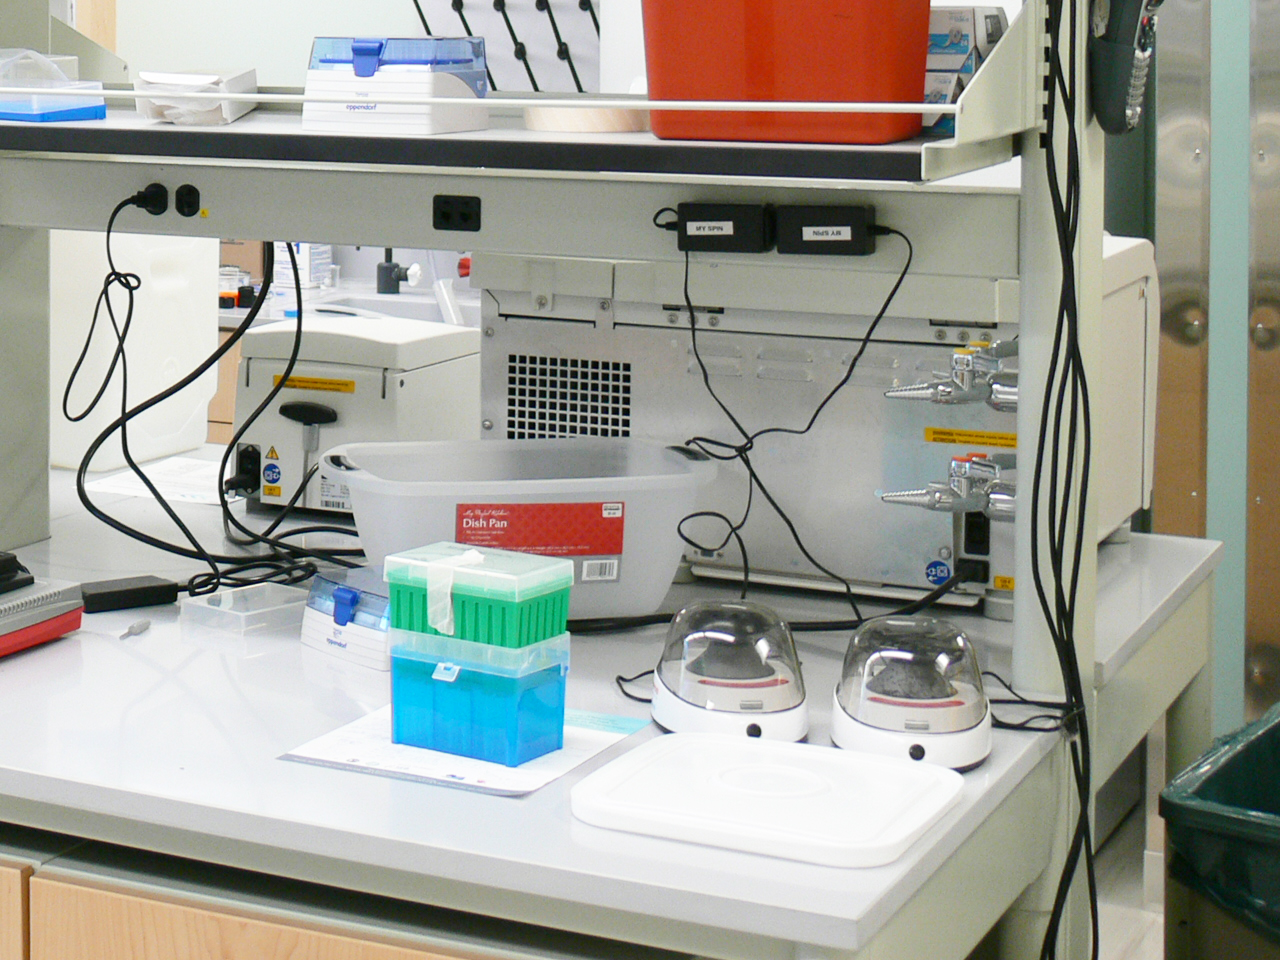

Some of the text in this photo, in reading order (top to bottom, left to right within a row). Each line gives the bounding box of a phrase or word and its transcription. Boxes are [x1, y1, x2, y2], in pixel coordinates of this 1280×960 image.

[346, 103, 377, 111] eppendorf
[463, 518, 508, 528] Dish Pan
